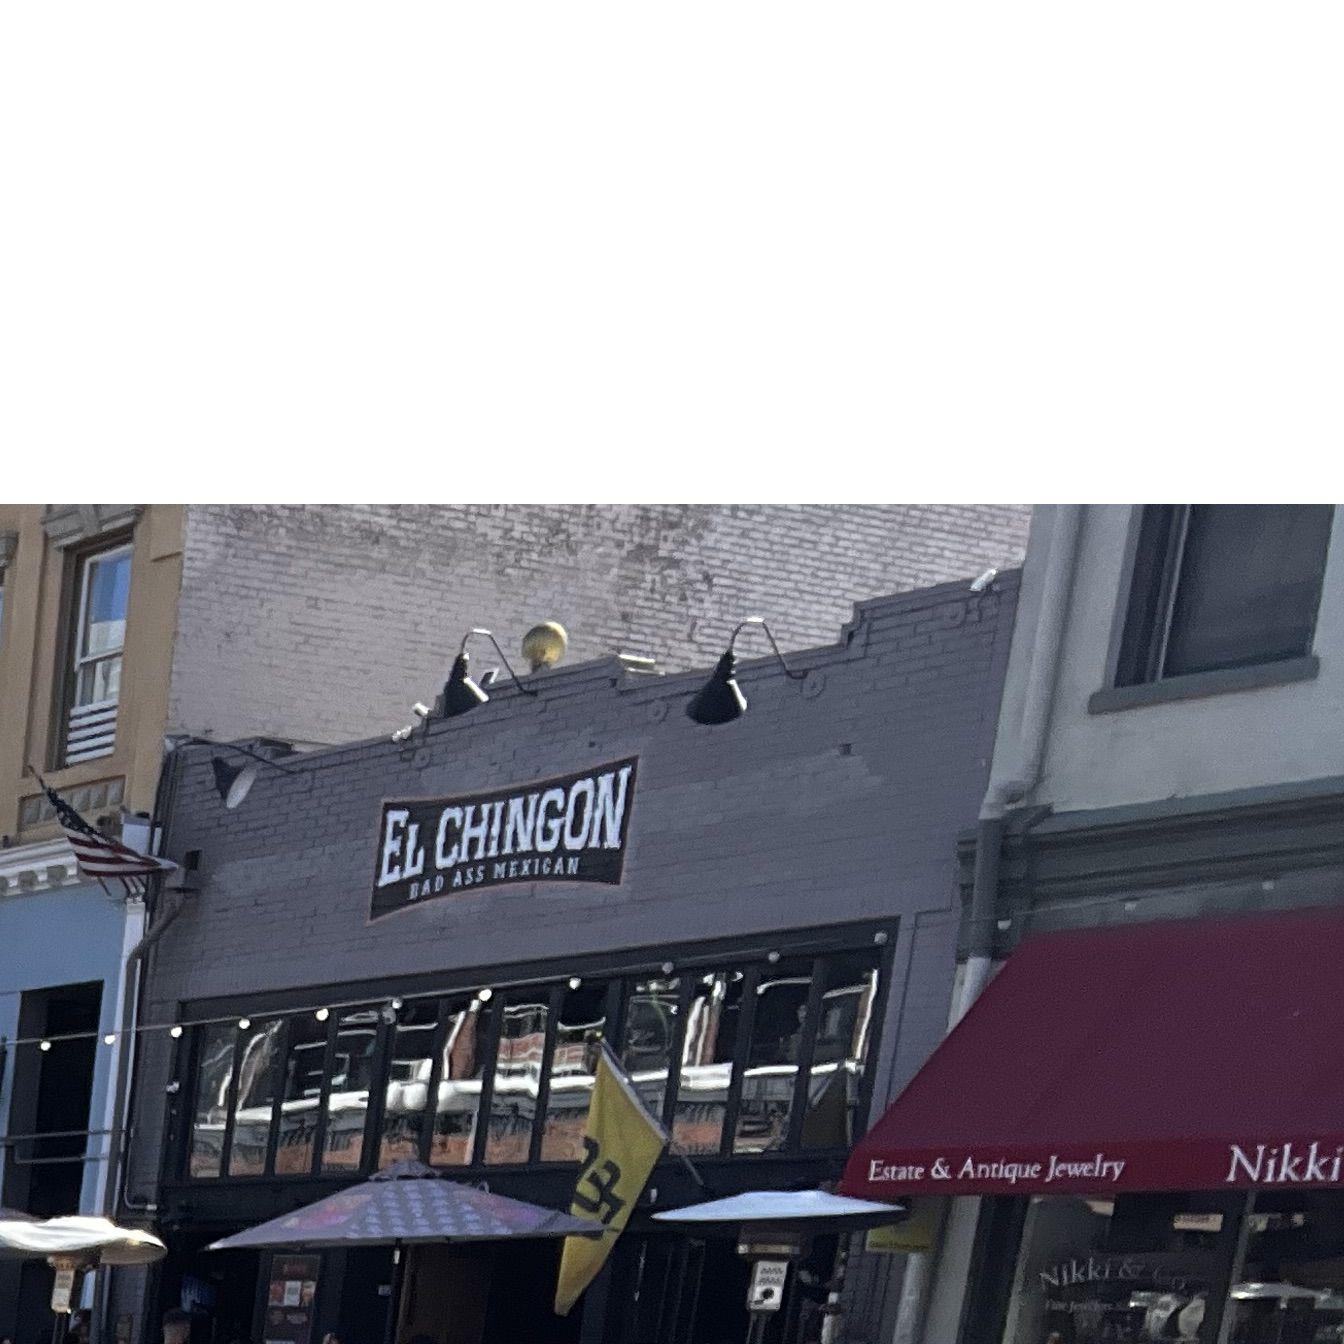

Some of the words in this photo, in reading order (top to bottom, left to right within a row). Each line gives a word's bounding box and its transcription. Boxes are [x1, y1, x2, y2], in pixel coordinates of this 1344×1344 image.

[377, 809, 424, 887] EL
[435, 765, 633, 870] CHINGON
[452, 864, 485, 888] ASS
[493, 856, 580, 881] MEXICAN
[868, 1159, 925, 1181] Estate
[930, 1157, 952, 1180] &
[957, 1156, 1042, 1184] Antique
[1044, 1152, 1126, 1182] Jewelry
[1225, 1142, 1344, 1183] Nikki
